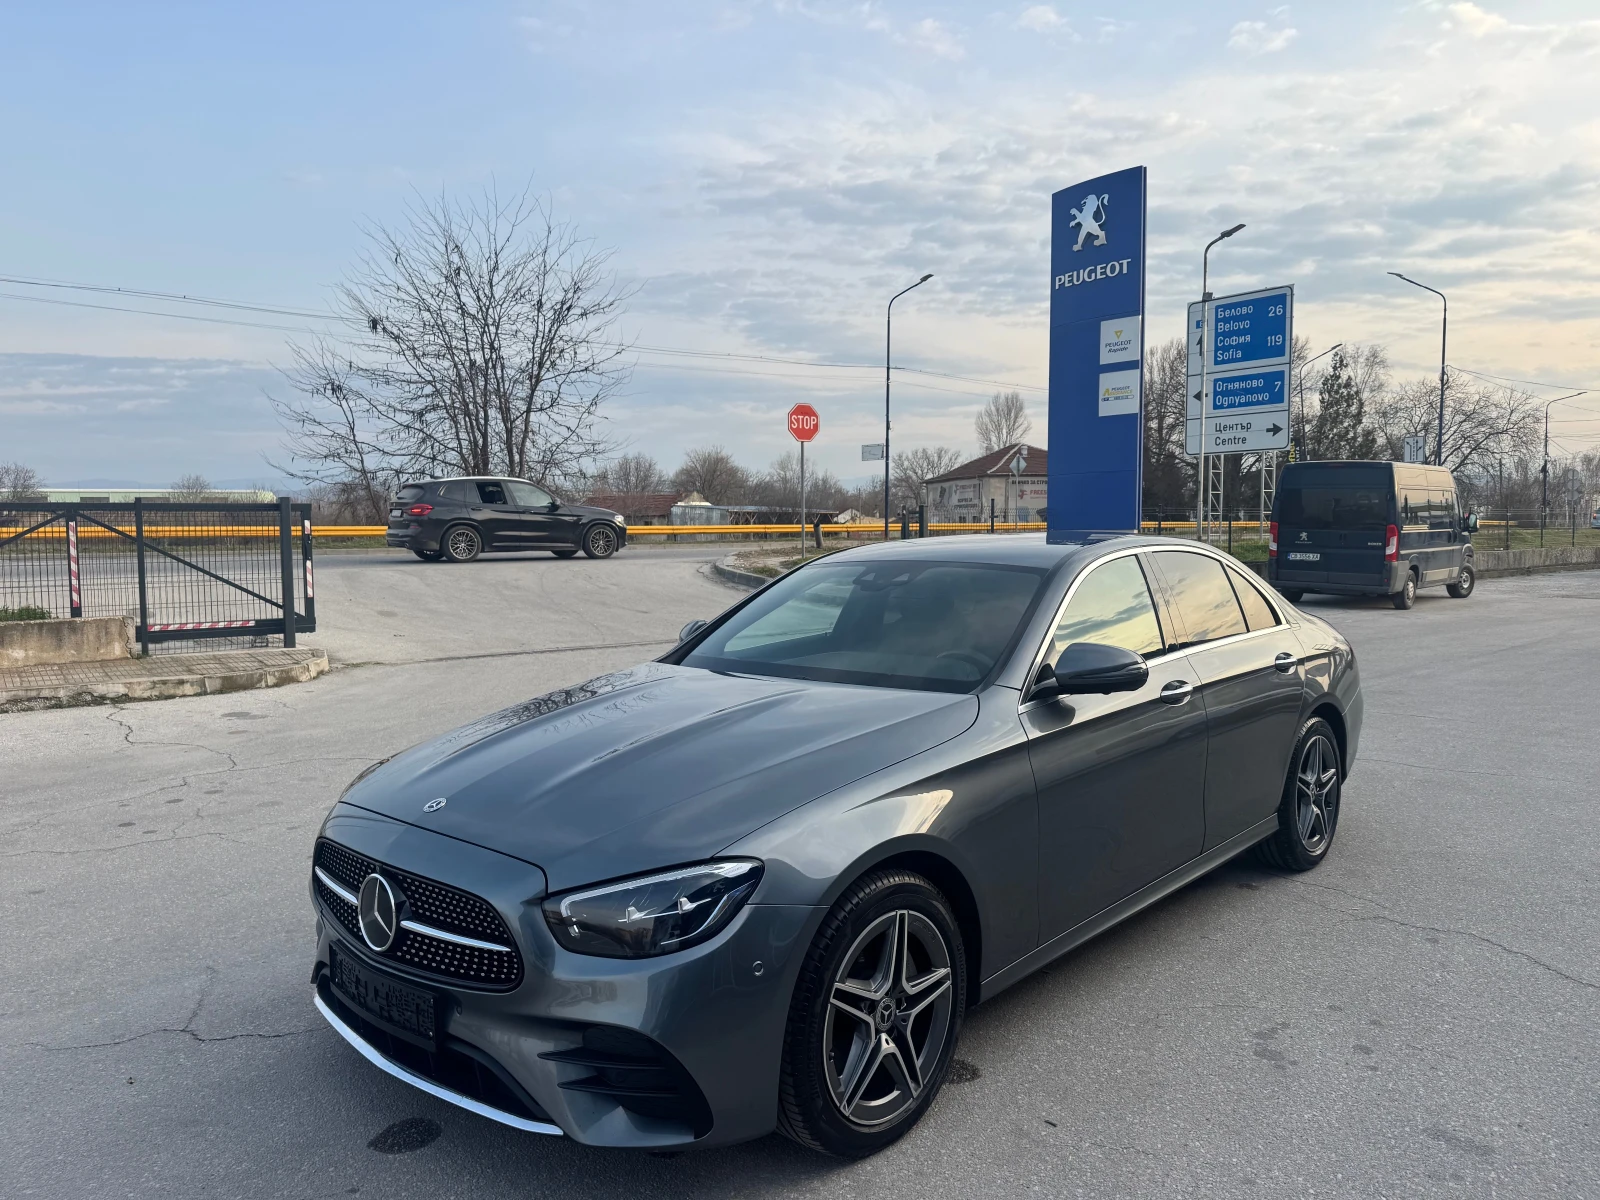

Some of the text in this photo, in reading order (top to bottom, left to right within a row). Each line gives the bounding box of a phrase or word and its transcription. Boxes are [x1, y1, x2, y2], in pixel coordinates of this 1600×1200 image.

[1055, 258, 1132, 290] PEUGEOT
[1217, 304, 1284, 319] Белово 26
[1217, 320, 1251, 333] Belovo
[1105, 339, 1132, 348] PEUGEOT
[1217, 334, 1283, 347] София 119
[1107, 346, 1129, 354] Rapide
[1216, 349, 1242, 361] Sofia
[1216, 378, 1282, 392] Огняново 7
[1216, 392, 1270, 406] Ognyanovo
[791, 415, 817, 430] STOP
[1215, 421, 1252, 434] Център
[1214, 436, 1247, 446] Centre
